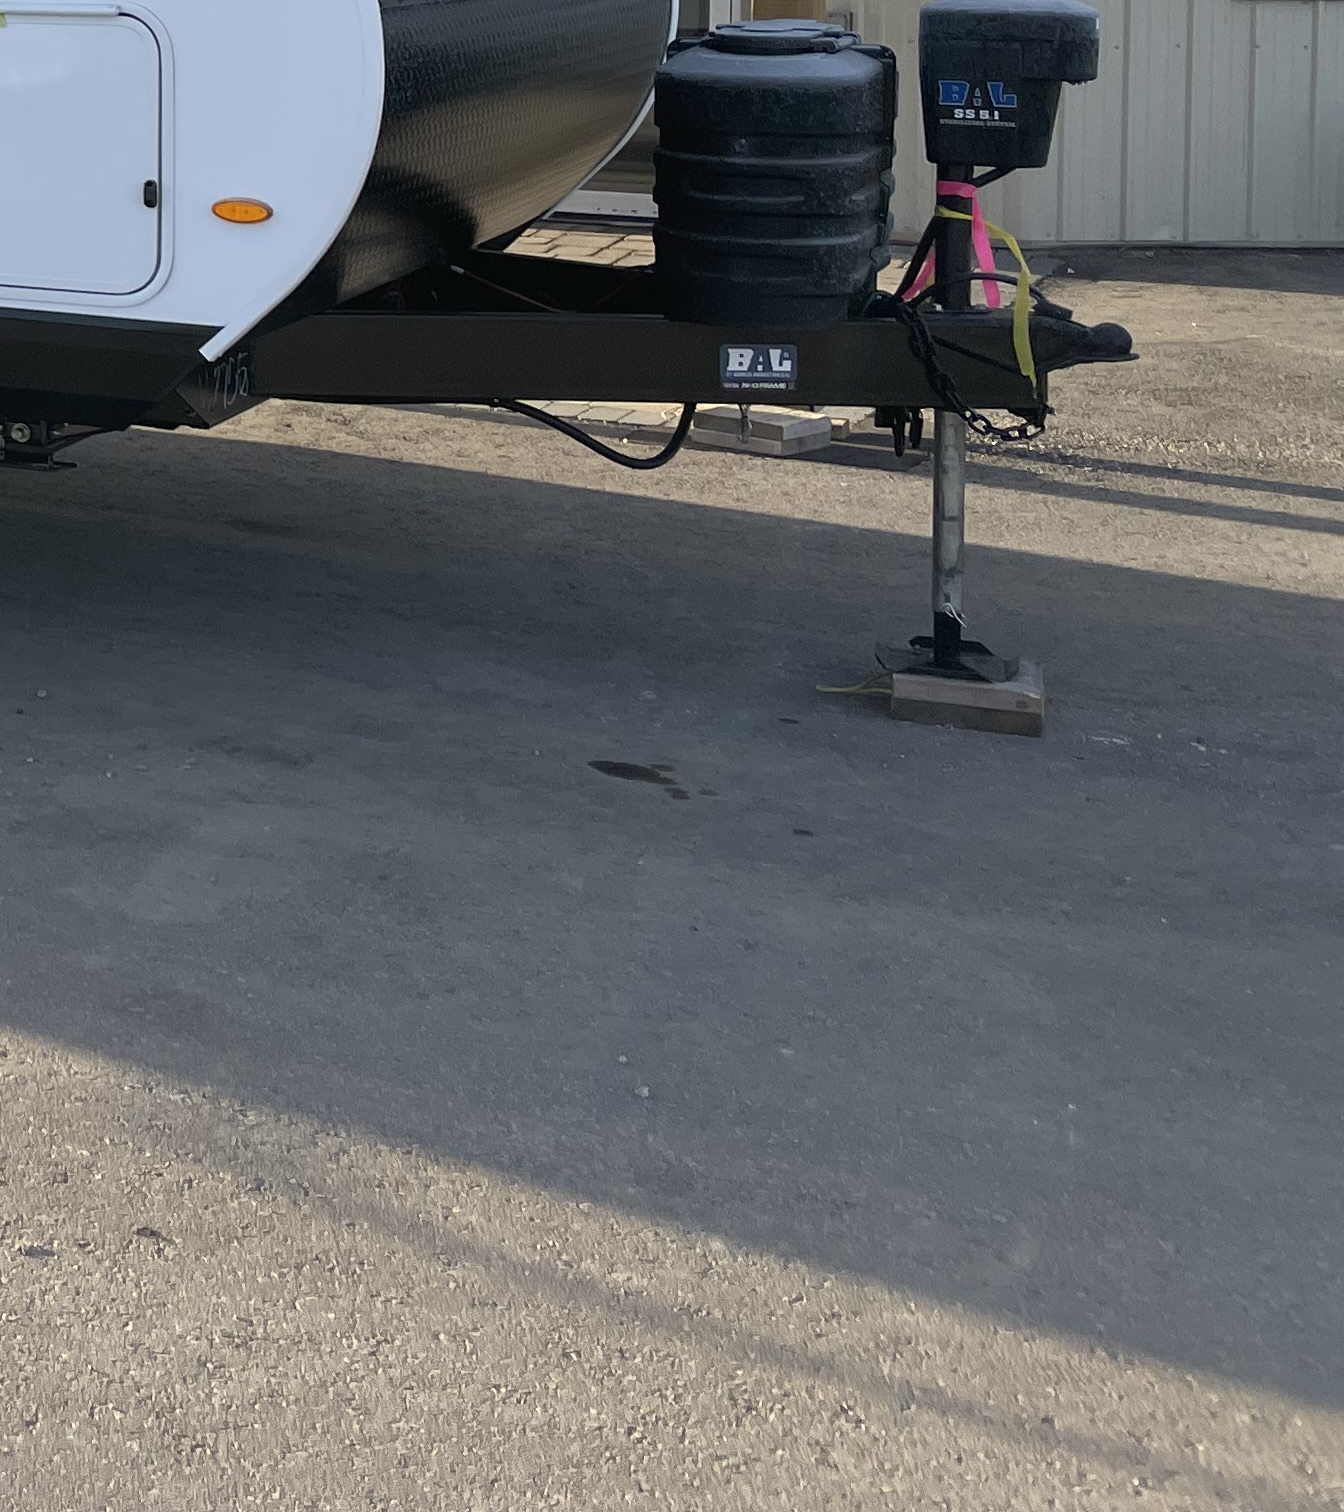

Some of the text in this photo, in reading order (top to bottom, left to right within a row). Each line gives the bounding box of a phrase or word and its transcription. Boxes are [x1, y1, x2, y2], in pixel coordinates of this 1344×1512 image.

[938, 79, 1018, 108] BAL
[953, 108, 976, 119] SS
[726, 348, 792, 372] BAL
